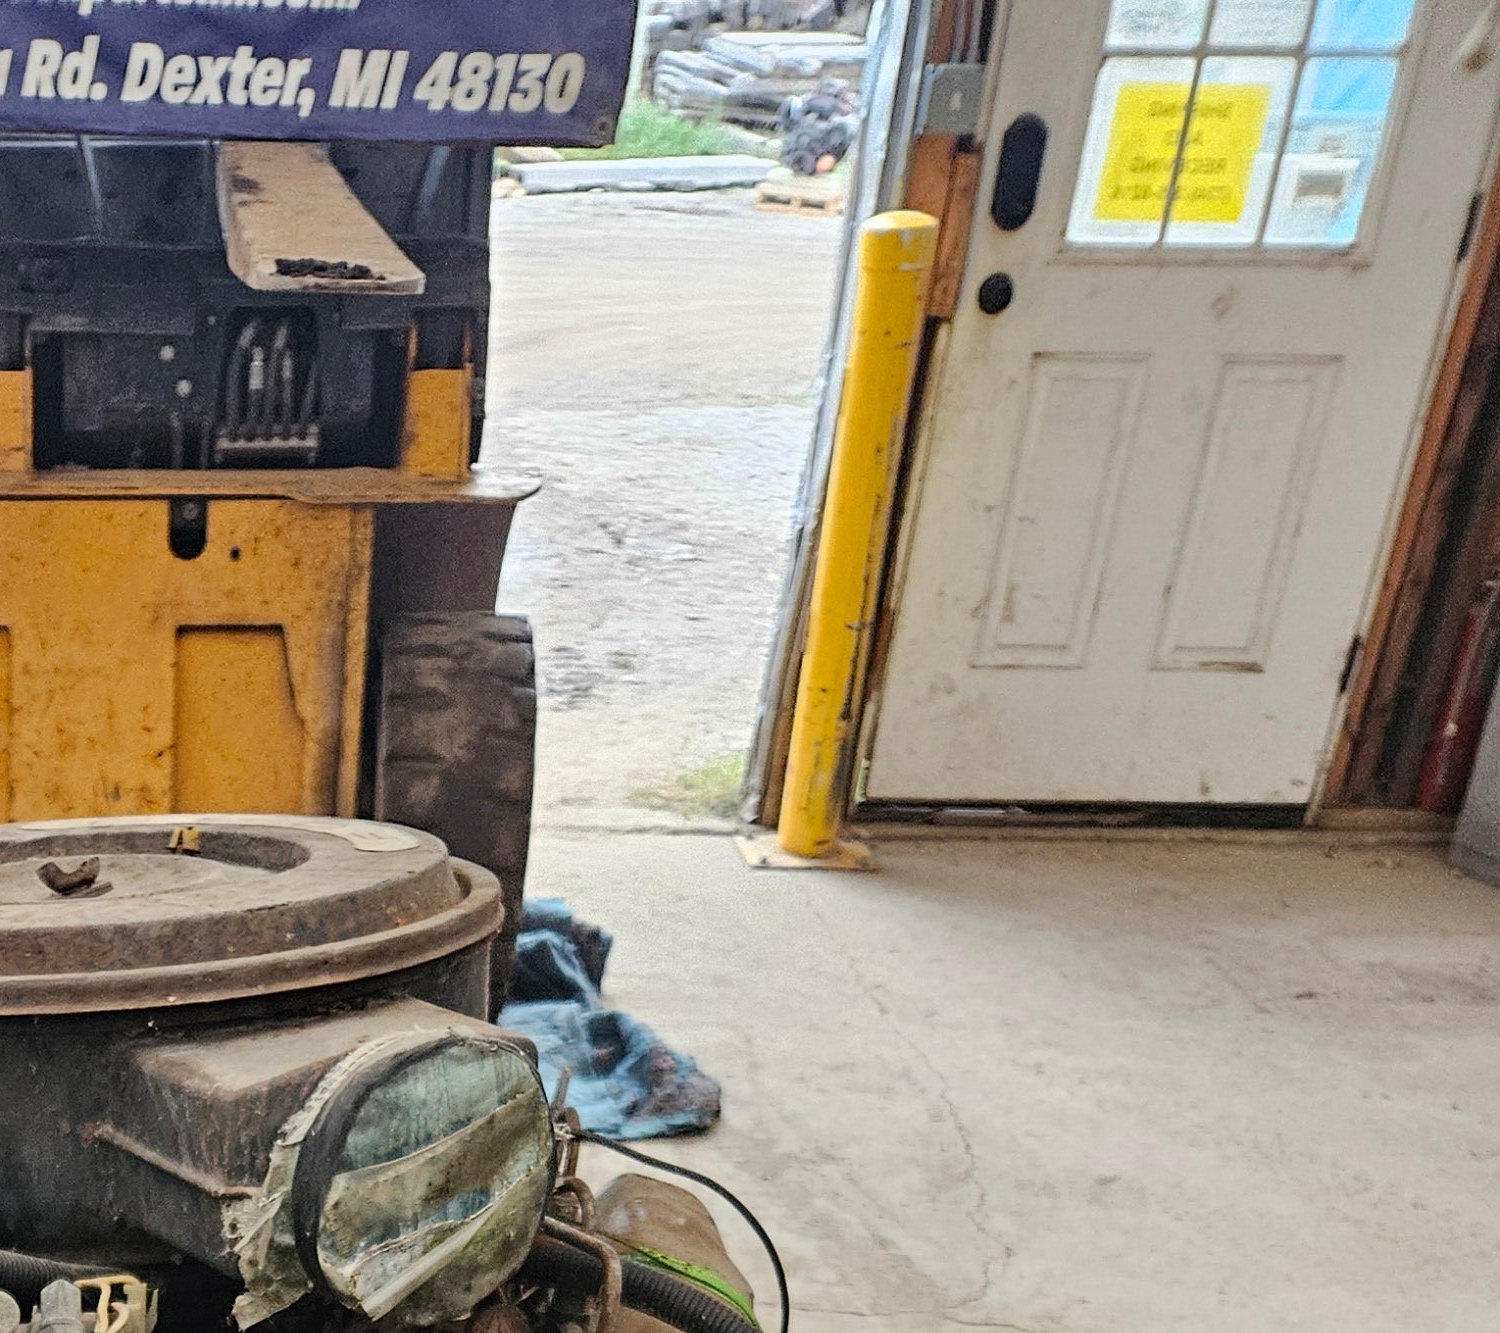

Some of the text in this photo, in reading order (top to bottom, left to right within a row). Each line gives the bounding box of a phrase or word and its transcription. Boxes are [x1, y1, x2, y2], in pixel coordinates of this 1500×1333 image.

[20, 35, 108, 102] Rd.
[120, 42, 316, 118] Dexter,
[328, 49, 409, 111] MI
[413, 51, 586, 116] 48130
